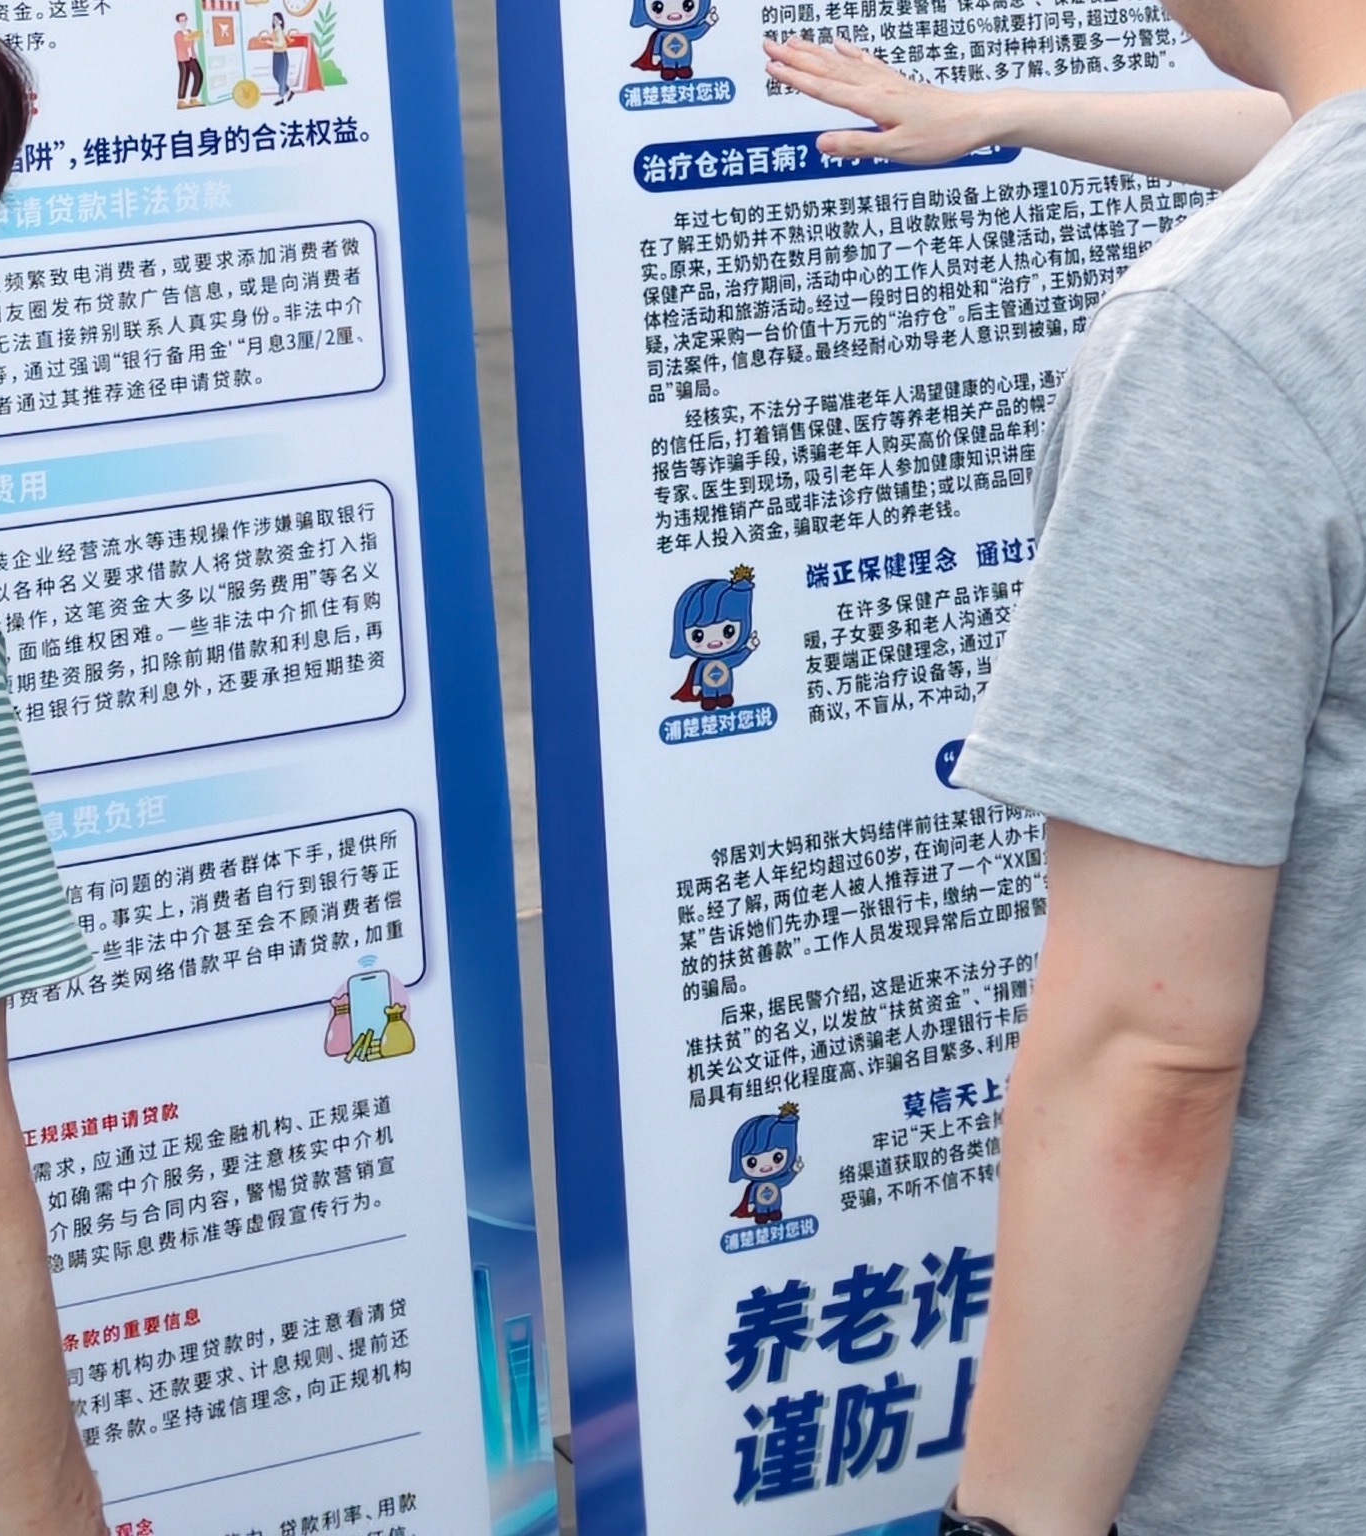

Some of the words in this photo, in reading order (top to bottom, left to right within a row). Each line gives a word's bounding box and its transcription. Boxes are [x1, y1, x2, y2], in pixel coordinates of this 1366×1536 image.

[623, 82, 732, 107] 浦楚楚对您说
[806, 546, 958, 591] 端正保健理念
[803, 603, 1017, 651] 暖，子女要多和老人沟通交
[663, 707, 774, 742] 浦楚楚对您说
[675, 822, 1047, 900] 现两名老人年纪均超过60岁，在询问老人办卡
[682, 975, 748, 1003] 的骗局。
[720, 952, 1039, 1026] 后来，据民警介绍，这是近来不法分子的
[903, 1073, 1010, 1120] 莫信天上
[23, 1102, 180, 1148] 正规渠道申请贷款
[840, 1161, 1000, 1212] 受骗，不听不信不转
[724, 1217, 816, 1251] 浦楚楚对您说
[724, 1246, 996, 1393] 养老诈
